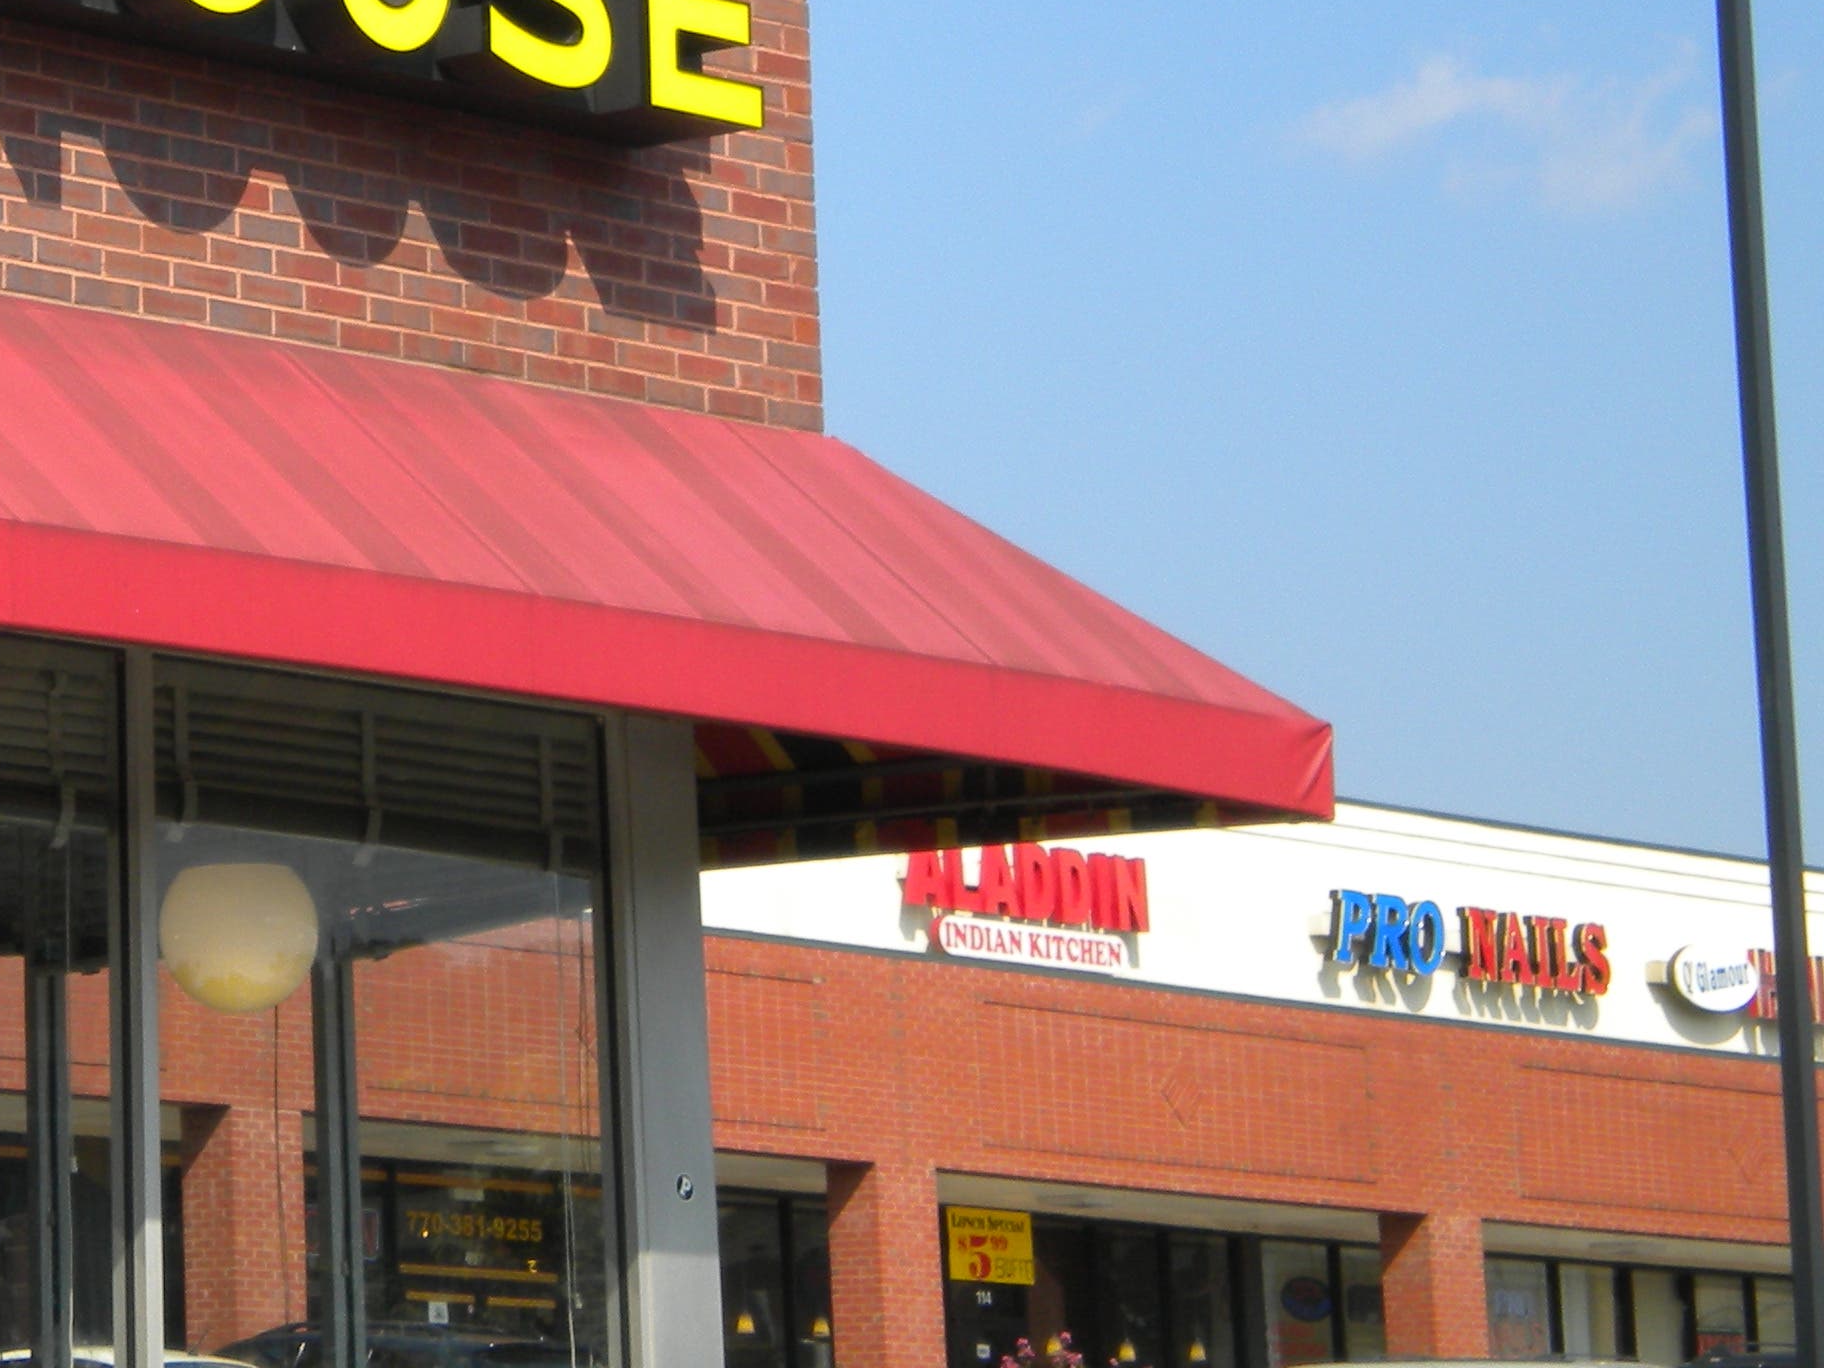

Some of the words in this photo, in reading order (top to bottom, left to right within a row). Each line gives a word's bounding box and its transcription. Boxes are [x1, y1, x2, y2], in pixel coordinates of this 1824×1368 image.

[904, 842, 1150, 932] ALADDIN
[945, 922, 1023, 955] INDIAN
[1029, 933, 1122, 967] KITCHEN
[1331, 889, 1446, 976] PRO
[1459, 906, 1612, 996] NAILS
